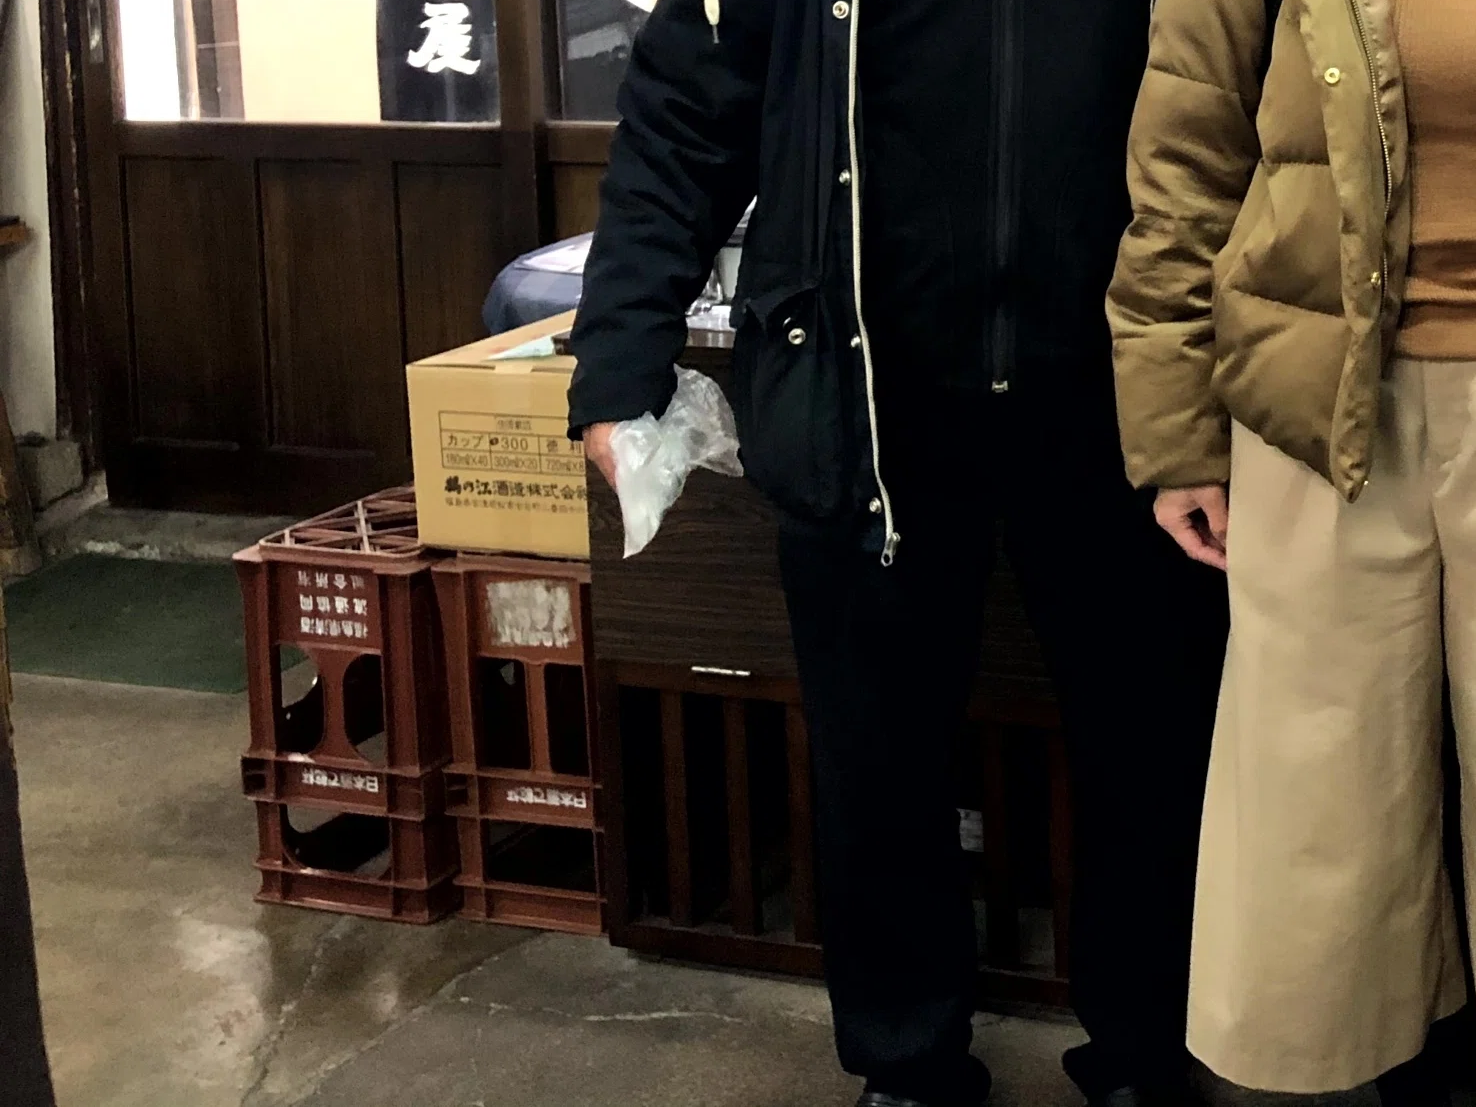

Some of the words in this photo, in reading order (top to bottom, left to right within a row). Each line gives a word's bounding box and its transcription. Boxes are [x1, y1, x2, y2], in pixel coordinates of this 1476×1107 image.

[448, 434, 484, 448] カップ
[500, 437, 529, 451] 300
